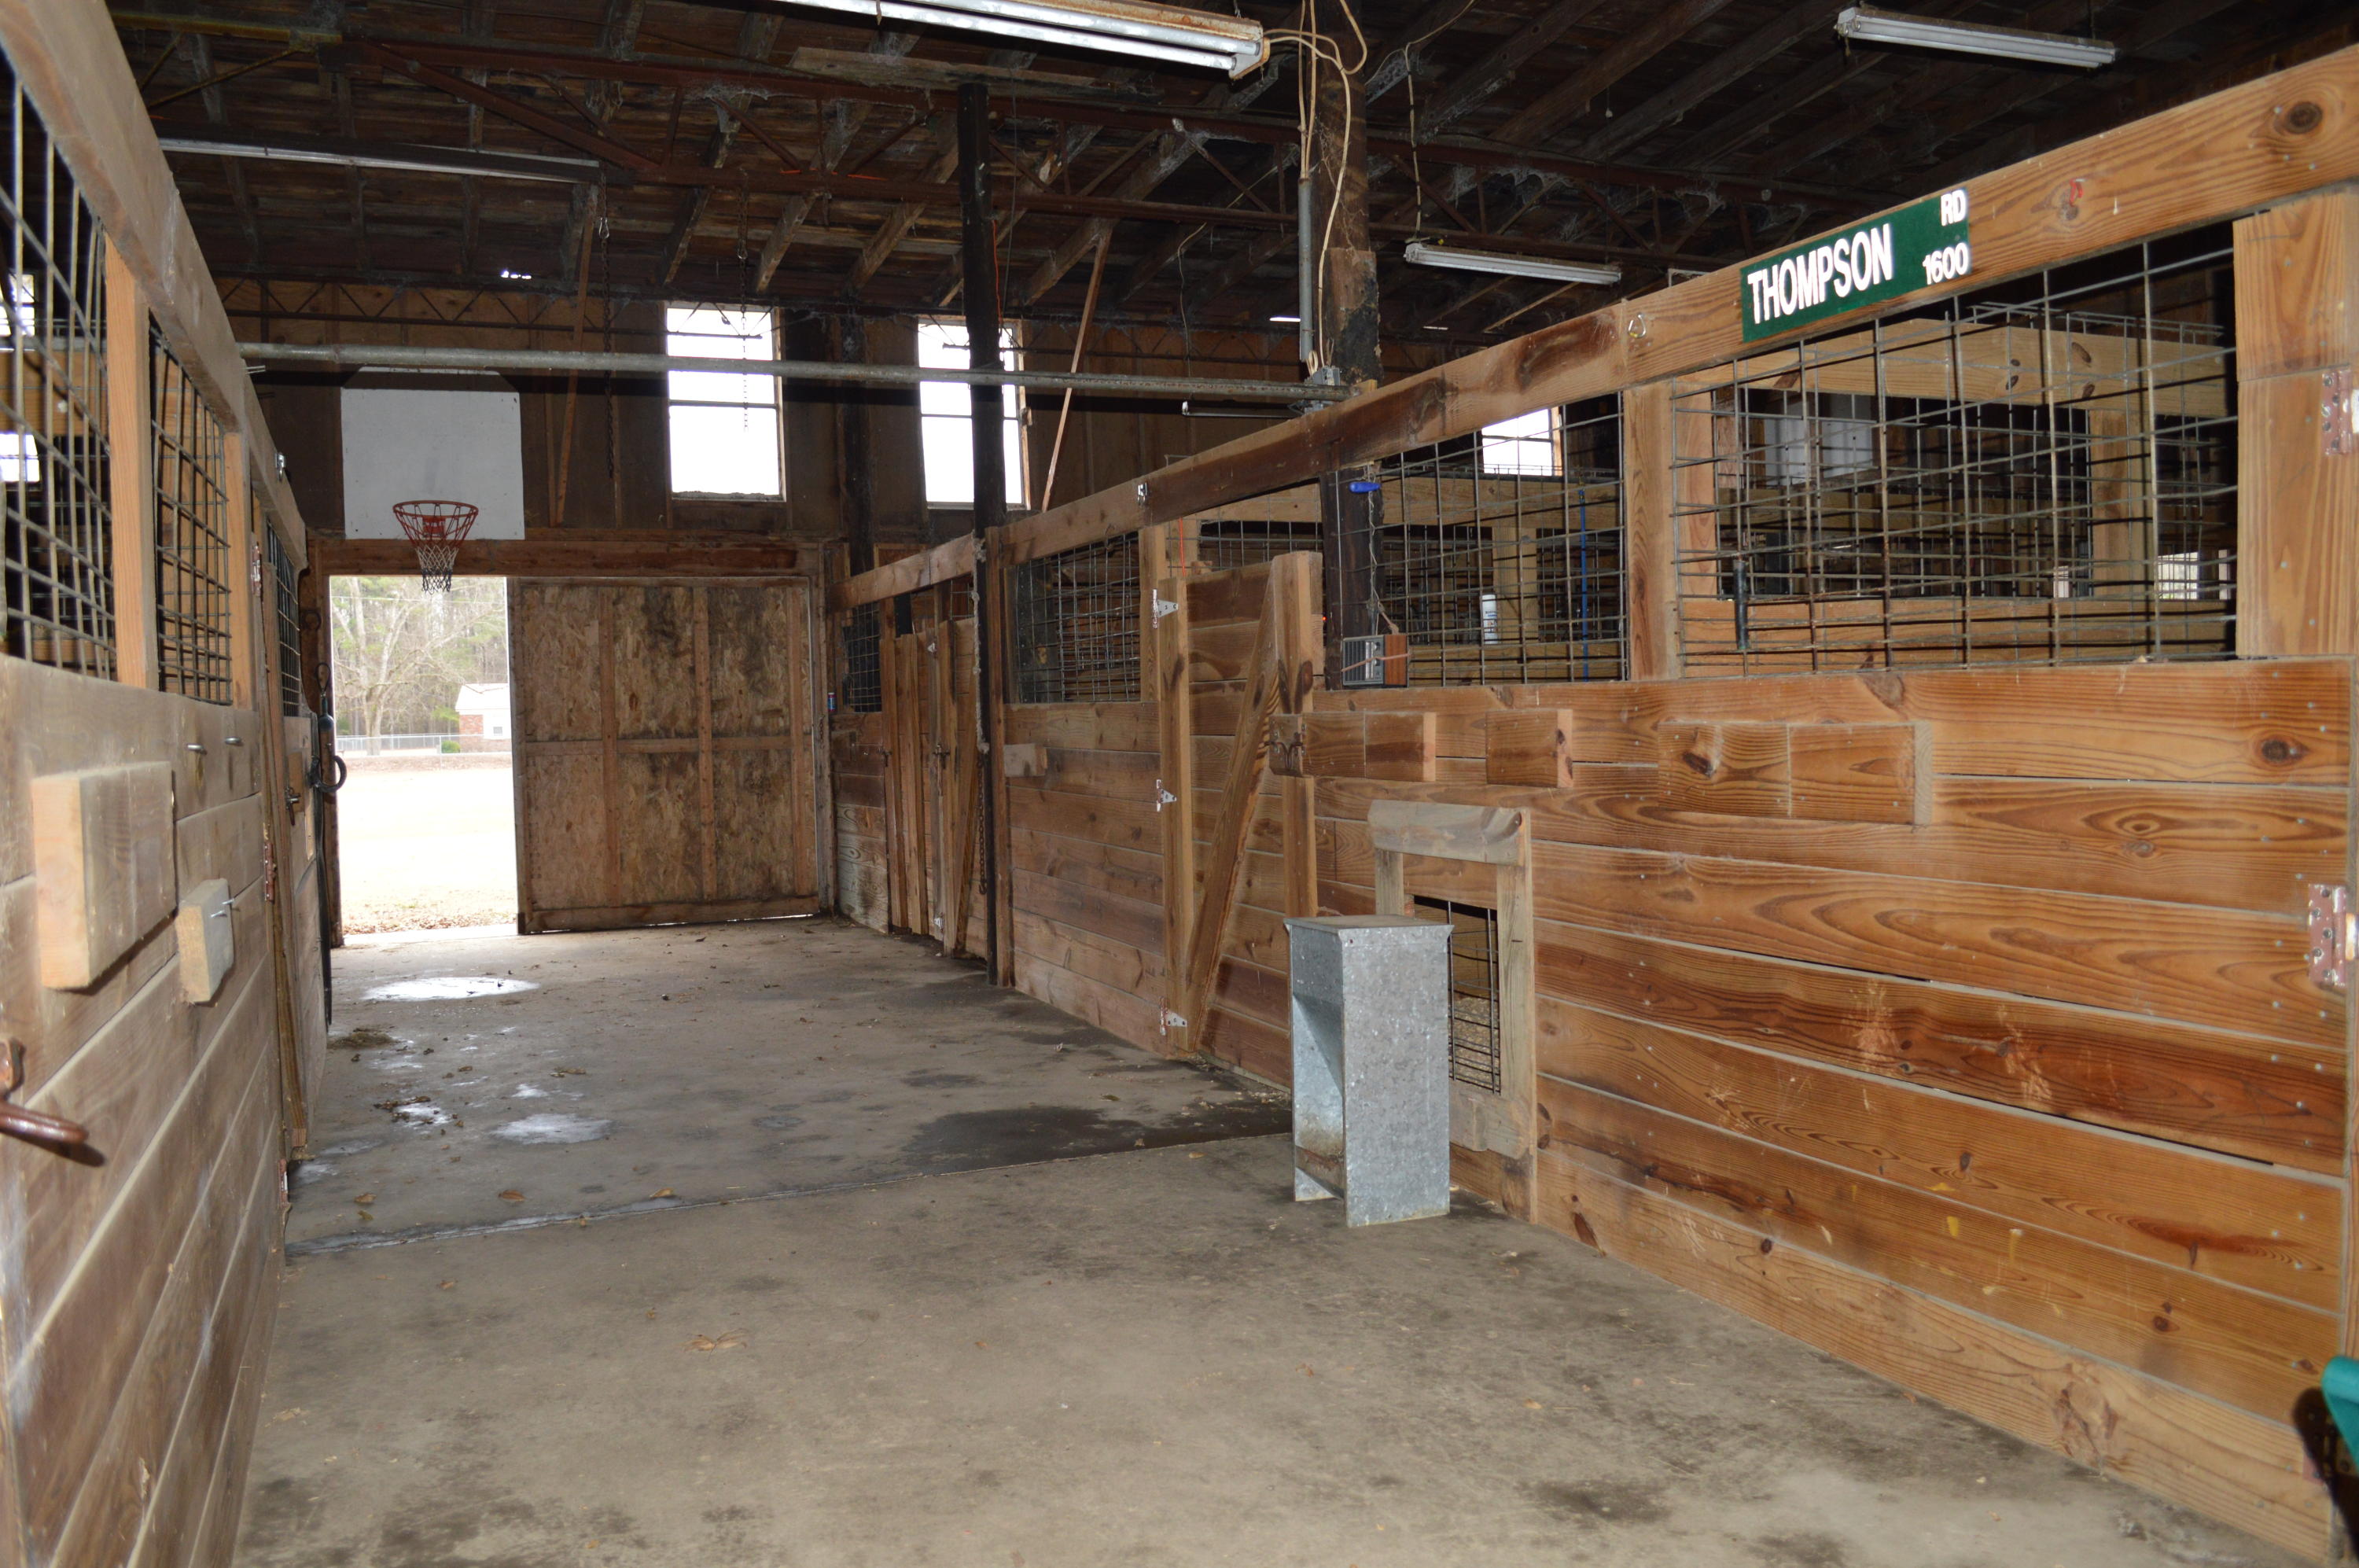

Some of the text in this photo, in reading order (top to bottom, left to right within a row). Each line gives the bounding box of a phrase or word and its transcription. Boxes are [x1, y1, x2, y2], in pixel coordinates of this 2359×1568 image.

[1747, 189, 1967, 324] THOMPSON RD
[1922, 242, 1970, 285] 1600
